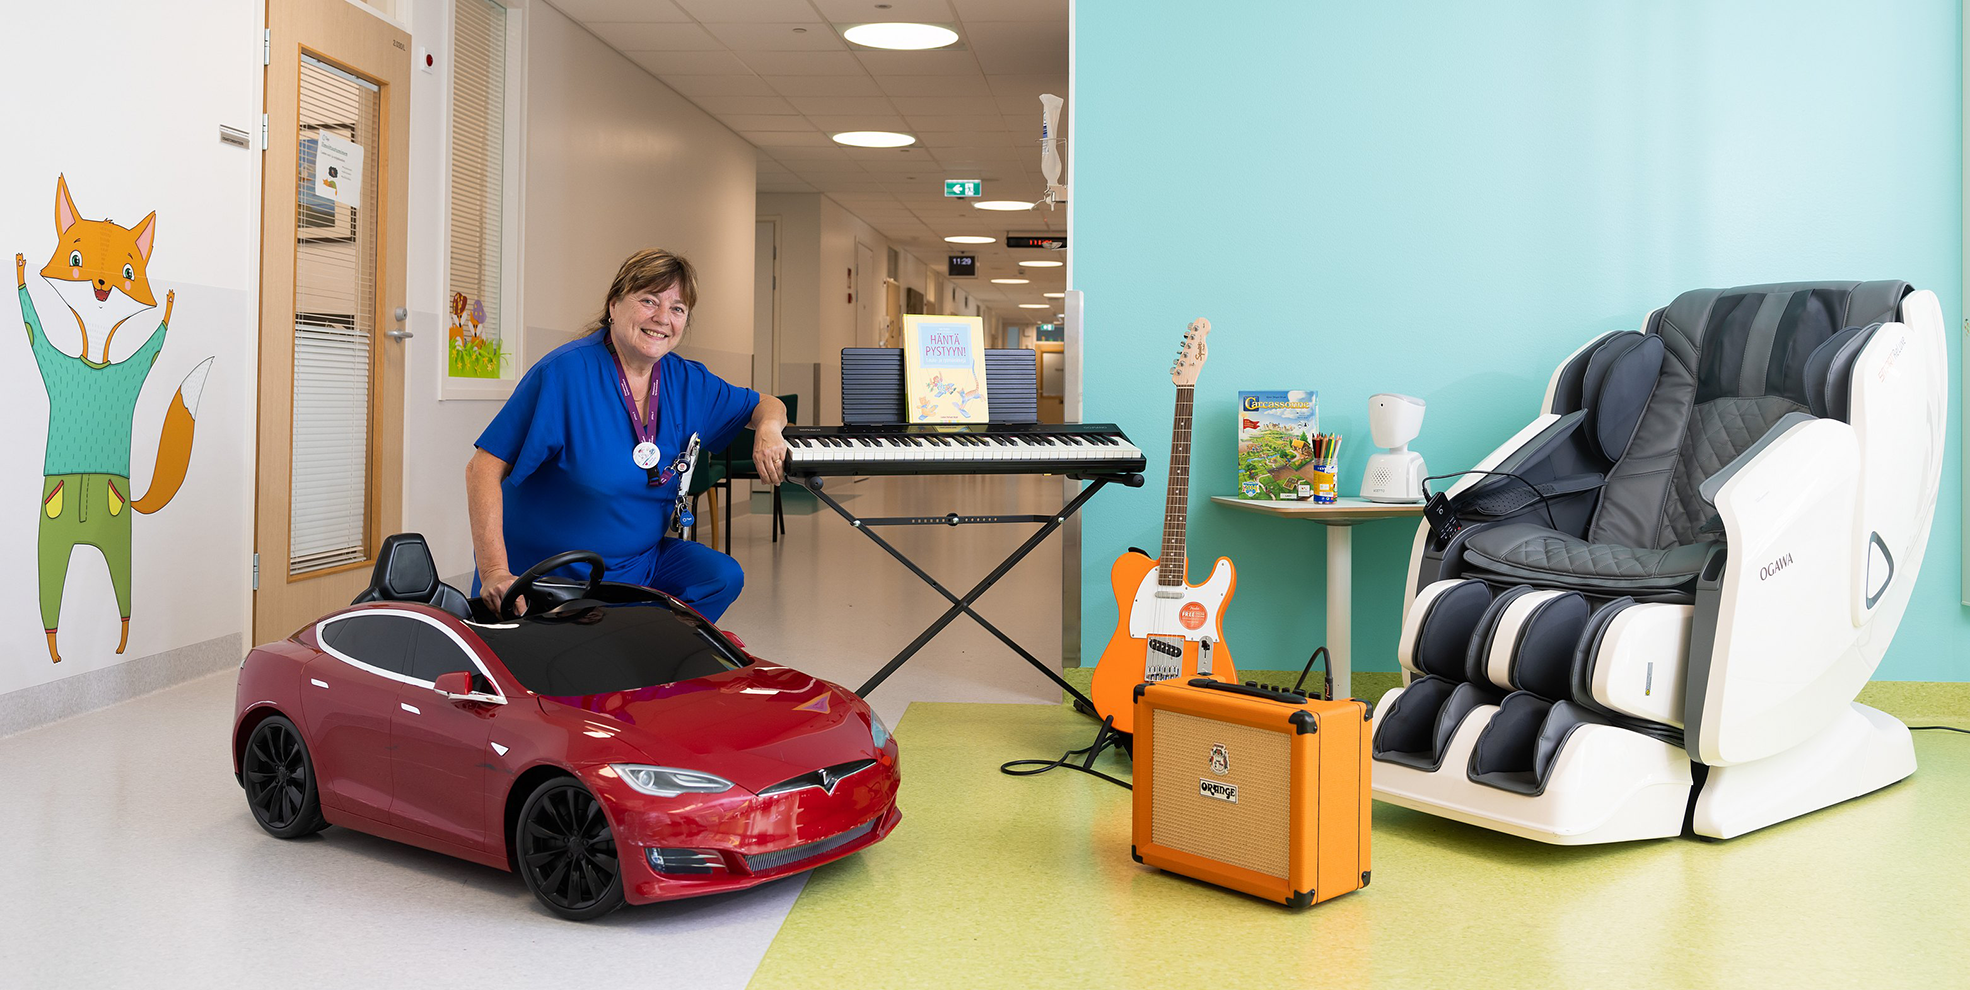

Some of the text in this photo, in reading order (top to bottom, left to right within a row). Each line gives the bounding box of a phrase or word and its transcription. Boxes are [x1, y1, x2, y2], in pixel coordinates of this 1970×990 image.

[930, 332, 960, 345] HÄNTÄ
[926, 346, 966, 357] PYSTYYN!
[1245, 397, 1309, 410] Carcassonne
[1760, 552, 1793, 581] OGAWA
[1201, 782, 1235, 799] ORANGE
